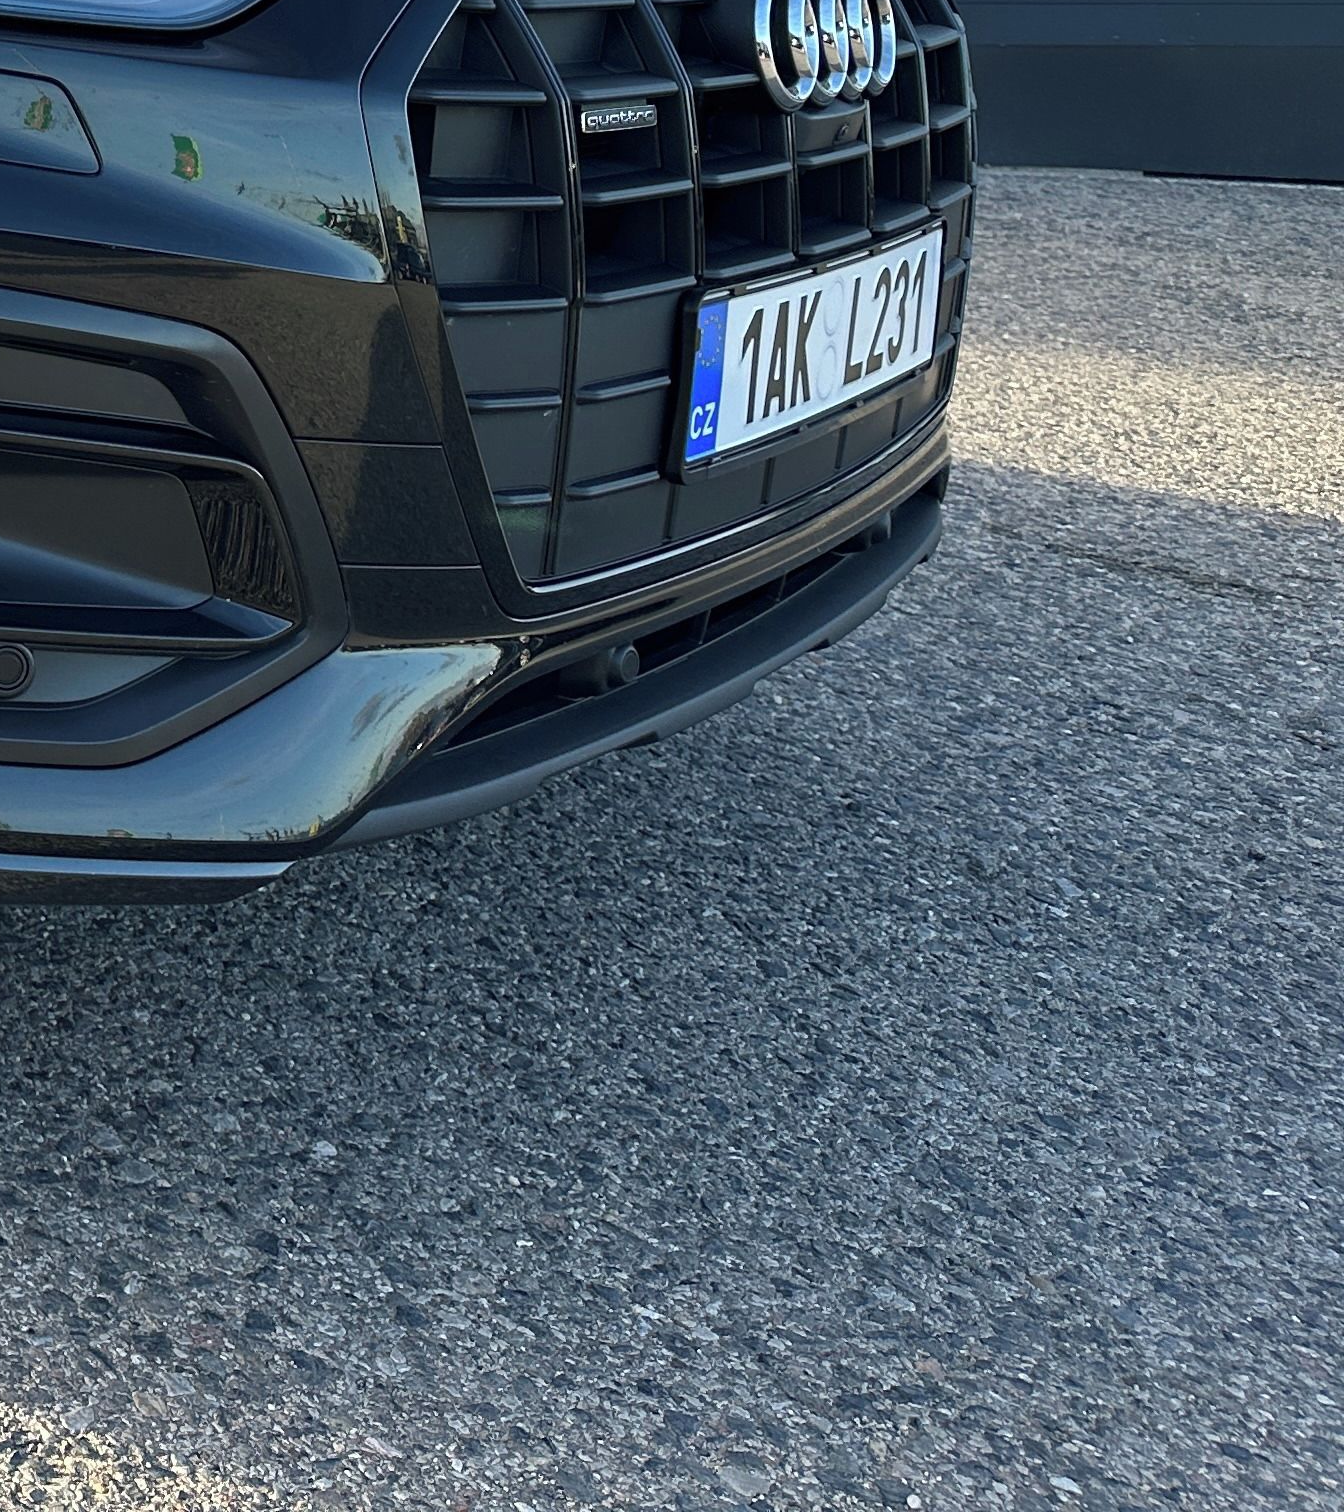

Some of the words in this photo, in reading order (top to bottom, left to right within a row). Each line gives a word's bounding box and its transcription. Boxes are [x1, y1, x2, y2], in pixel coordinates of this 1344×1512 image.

[587, 110, 654, 130] quattro
[740, 290, 823, 425] 1AK
[843, 248, 928, 386] L231
[690, 401, 716, 440] CZ
